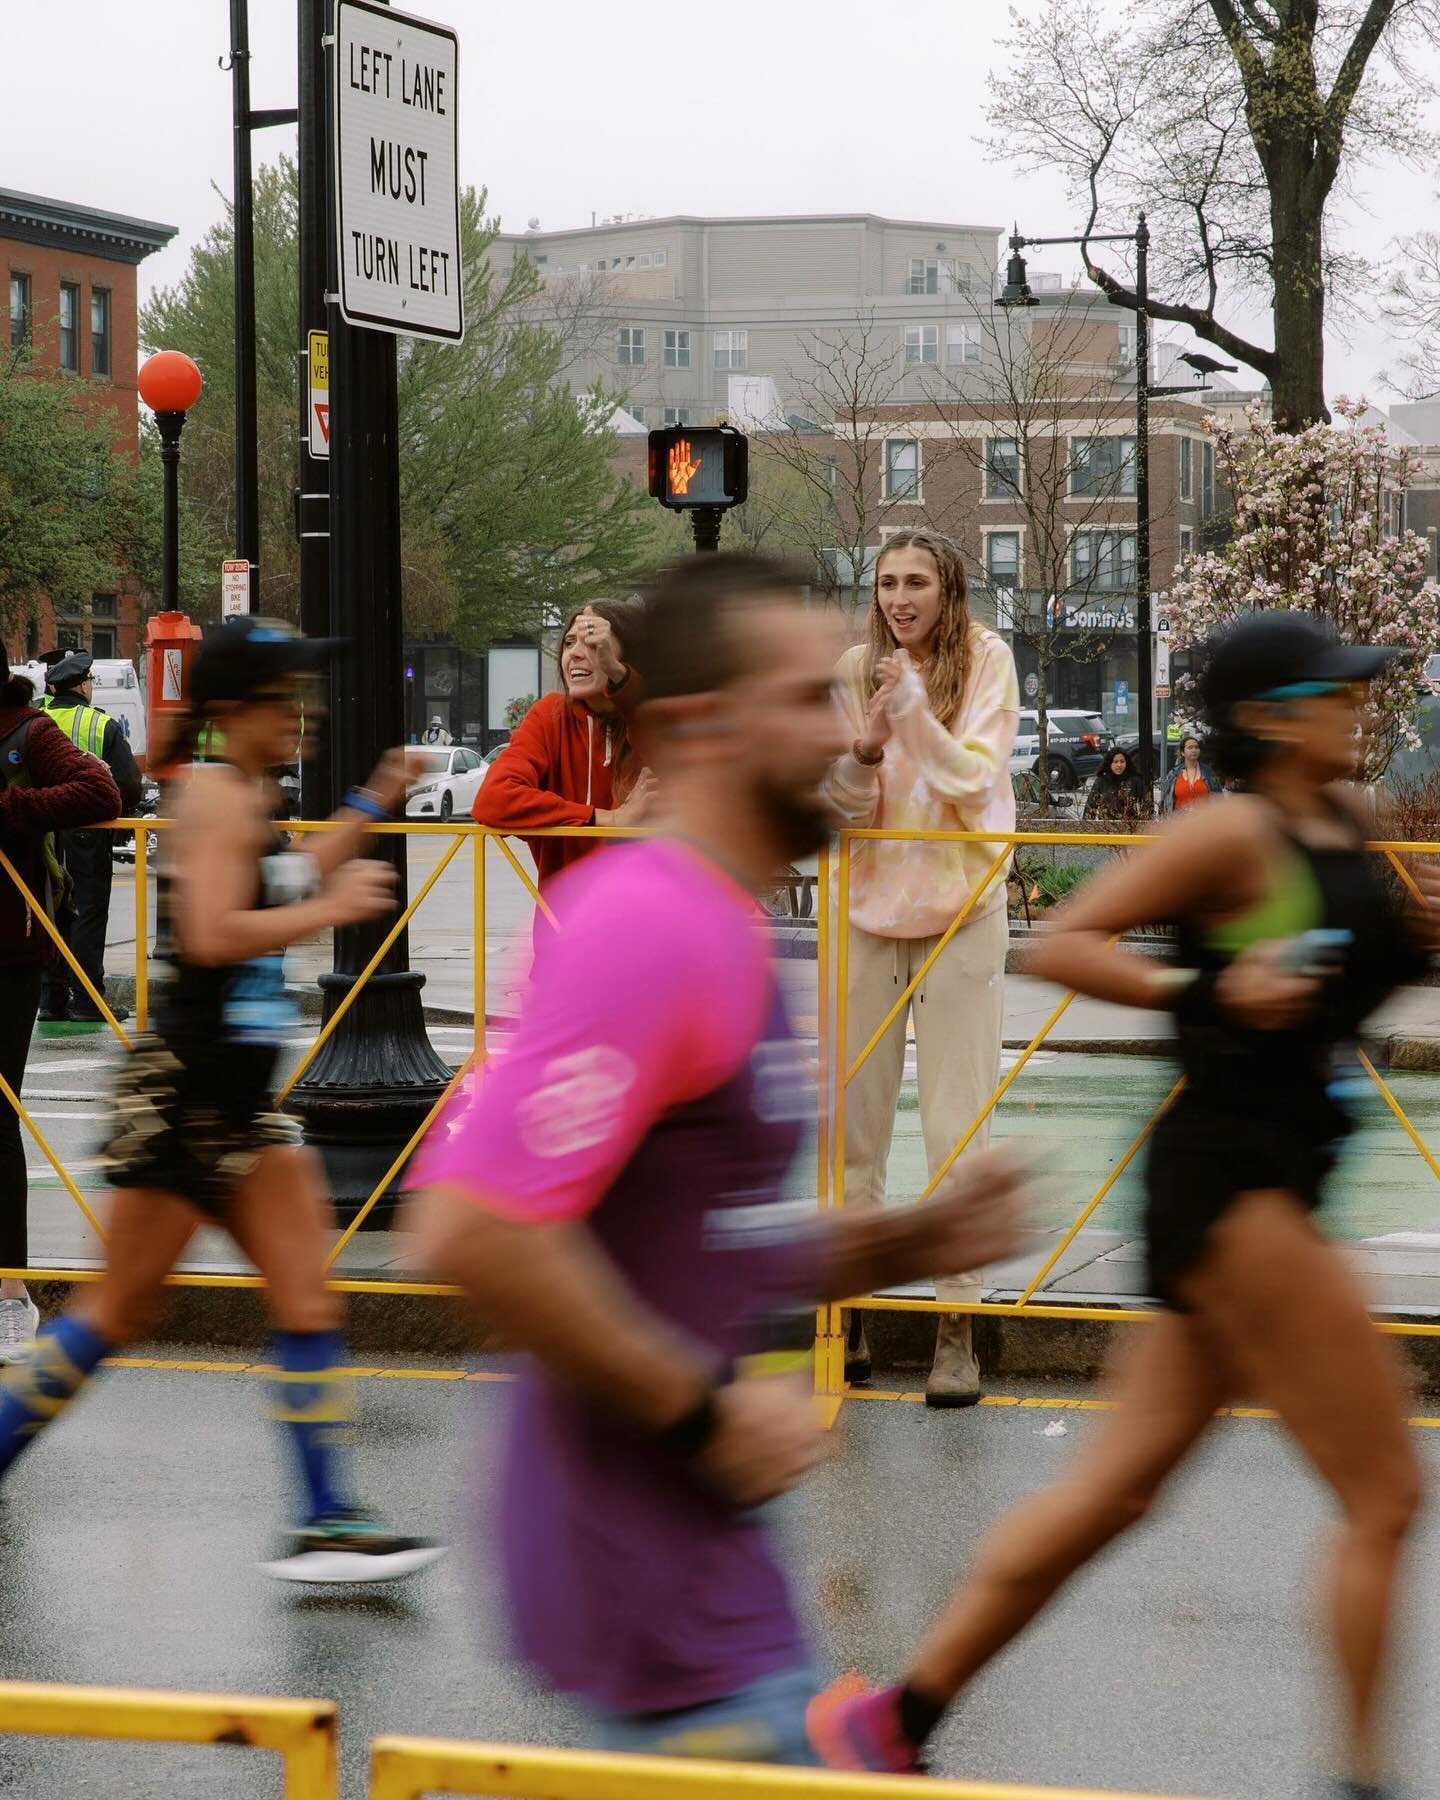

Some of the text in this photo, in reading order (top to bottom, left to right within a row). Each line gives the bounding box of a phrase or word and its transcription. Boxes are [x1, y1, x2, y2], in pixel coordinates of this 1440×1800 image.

[350, 42, 446, 116] LEFT LANE
[370, 136, 428, 206] MUST
[351, 230, 449, 297] TURN LEFT
[223, 563, 248, 572] TOW ZONE
[231, 574, 240, 582] NO
[225, 583, 247, 592] STOPPING
[230, 593, 241, 602] BIKE
[230, 603, 241, 611] LANE
[1065, 603, 1135, 628] Domino's
